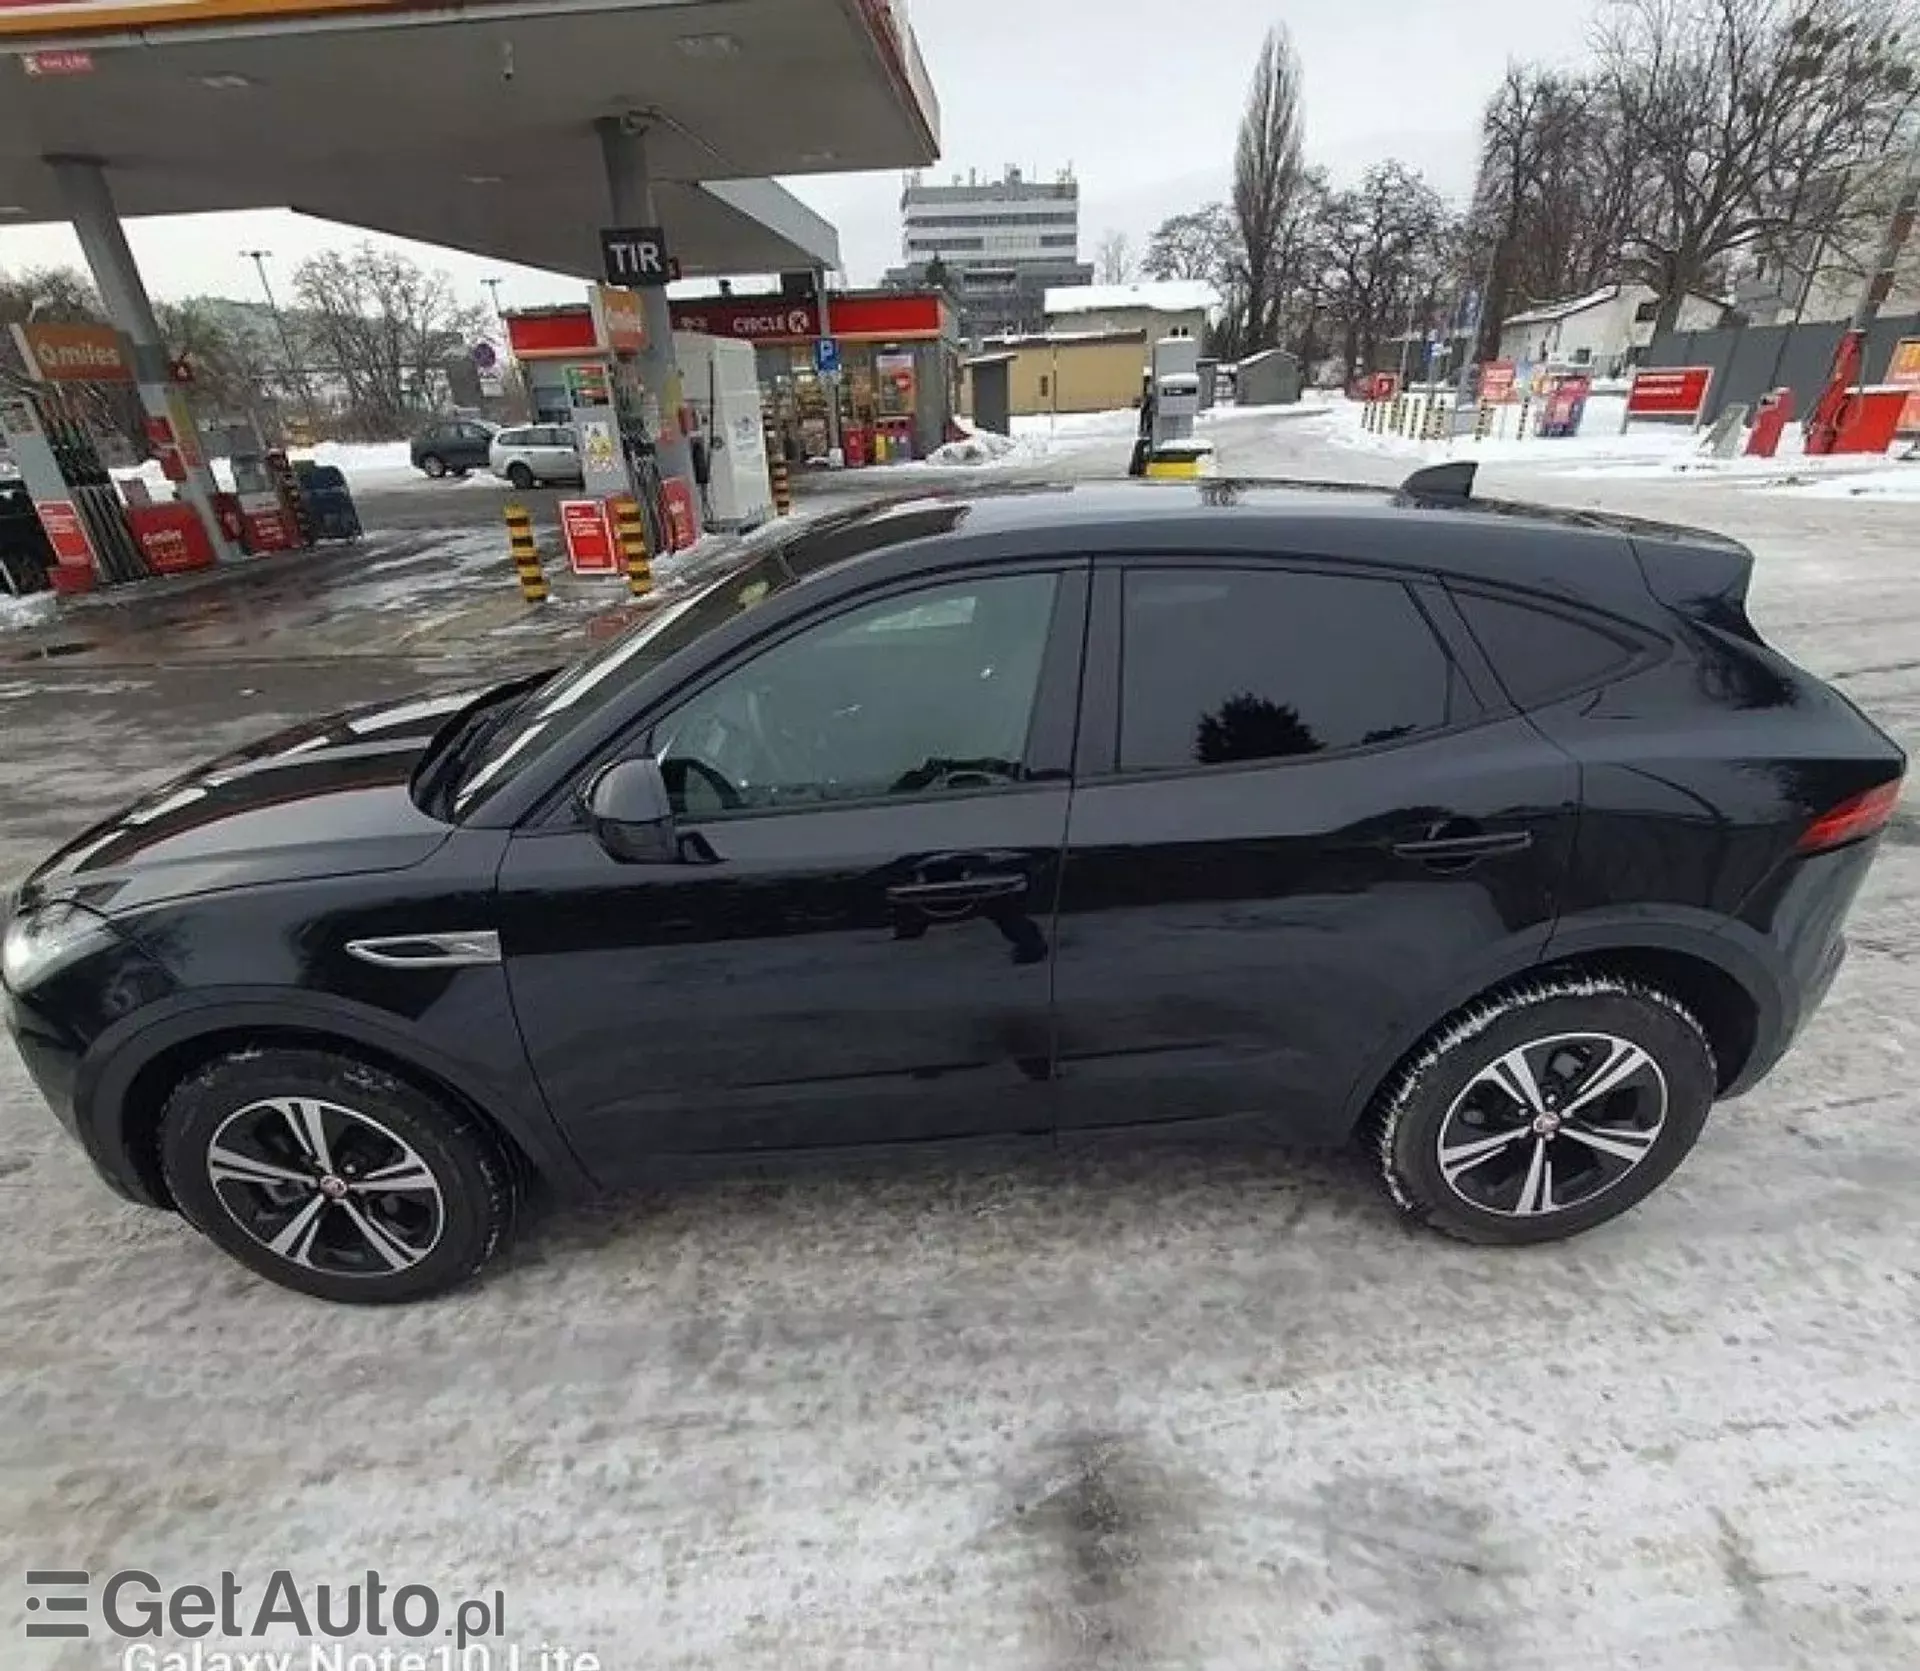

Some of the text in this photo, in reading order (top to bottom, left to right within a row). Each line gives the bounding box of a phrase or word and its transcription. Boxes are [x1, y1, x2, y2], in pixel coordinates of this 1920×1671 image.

[608, 241, 663, 273] TIR
[733, 314, 786, 333] CIRCLE
[820, 340, 834, 362] P
